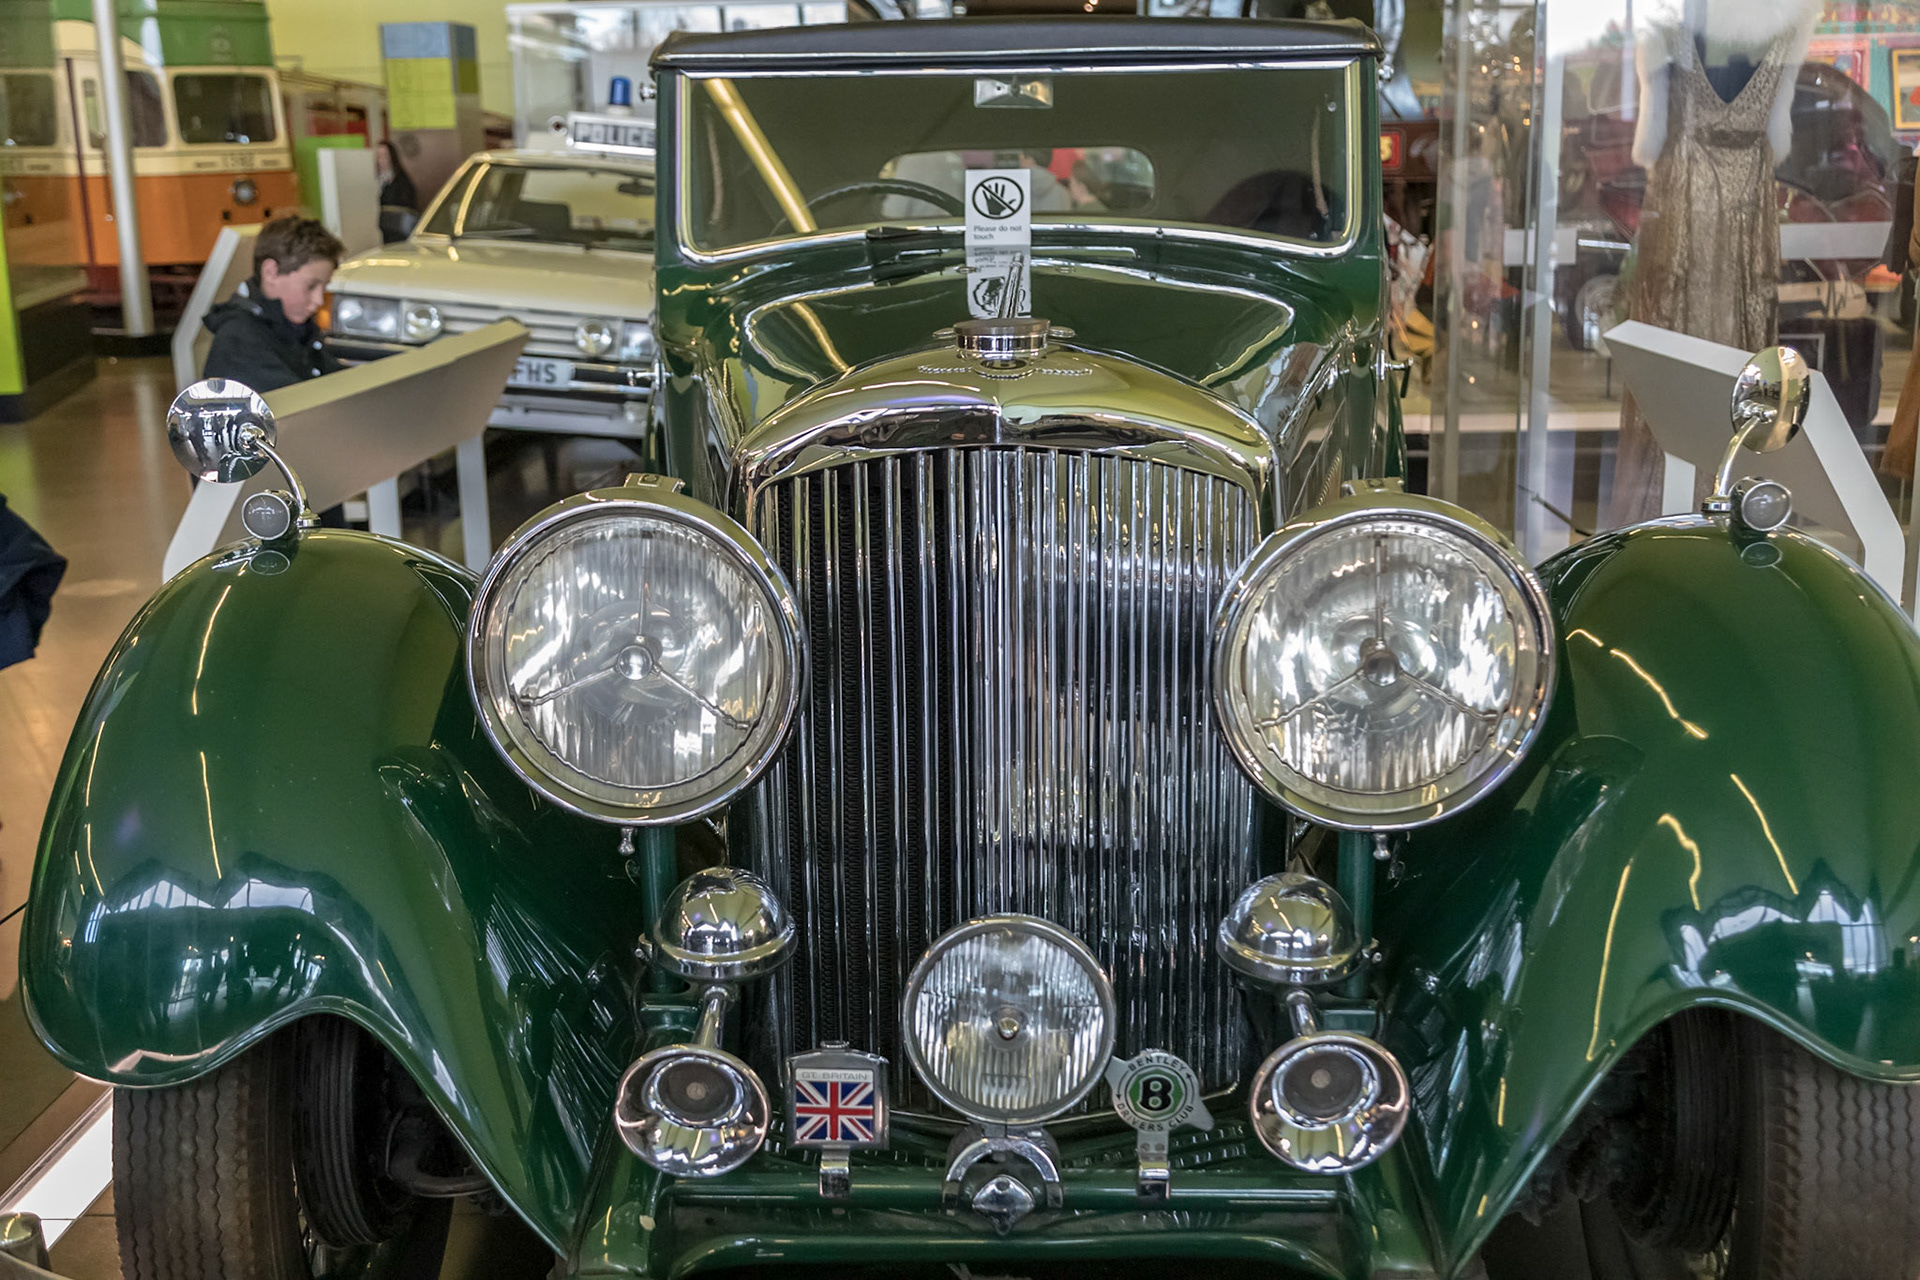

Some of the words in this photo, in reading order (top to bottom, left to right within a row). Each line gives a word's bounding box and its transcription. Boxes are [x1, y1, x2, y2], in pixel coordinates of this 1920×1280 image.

[575, 123, 656, 147] POLICE
[1128, 1055, 1187, 1072] BENTLEY
[822, 1072, 868, 1081] BRITAIN
[1137, 1074, 1173, 1112] B
[1117, 1102, 1164, 1131] DRIVERS
[1168, 1104, 1195, 1128] CLUB
